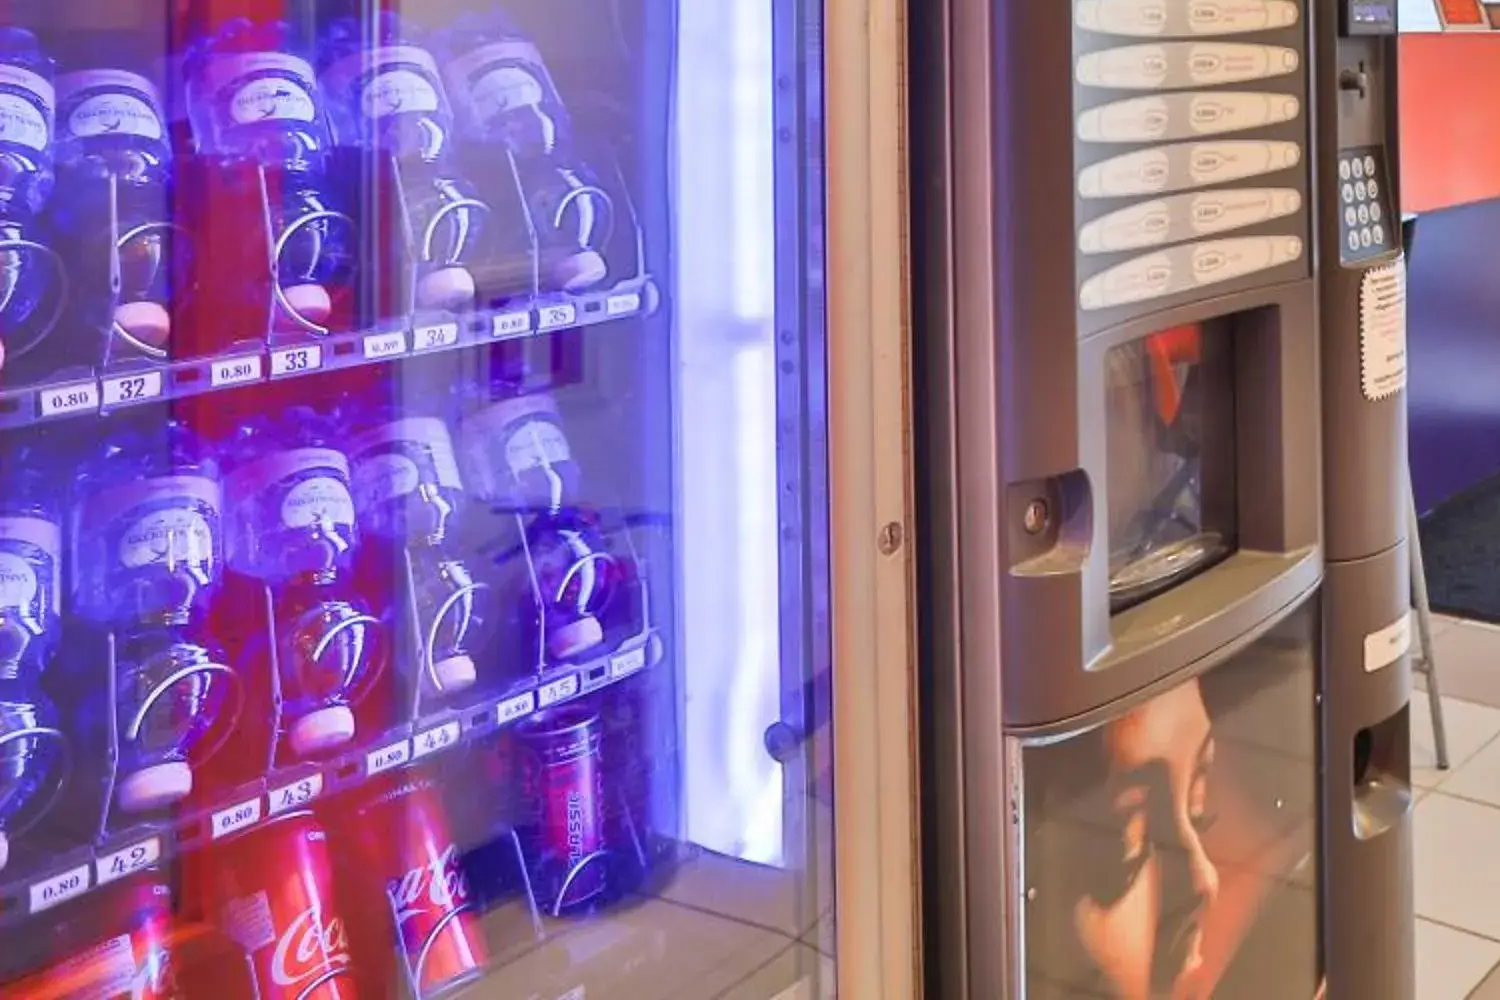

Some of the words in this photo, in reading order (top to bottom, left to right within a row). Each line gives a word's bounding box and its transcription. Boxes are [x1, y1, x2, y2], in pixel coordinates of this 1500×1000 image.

[549, 308, 567, 324] 35
[426, 329, 445, 346] 34
[285, 351, 308, 371] 33
[221, 364, 252, 380] 0.80
[119, 378, 146, 400] 32
[52, 391, 89, 408] 0.80
[424, 728, 449, 749] 44
[375, 749, 403, 768] 0.80
[281, 780, 312, 806] 43
[221, 807, 253, 829] 0.80
[110, 847, 147, 873] 42
[42, 874, 80, 900] 0.80
